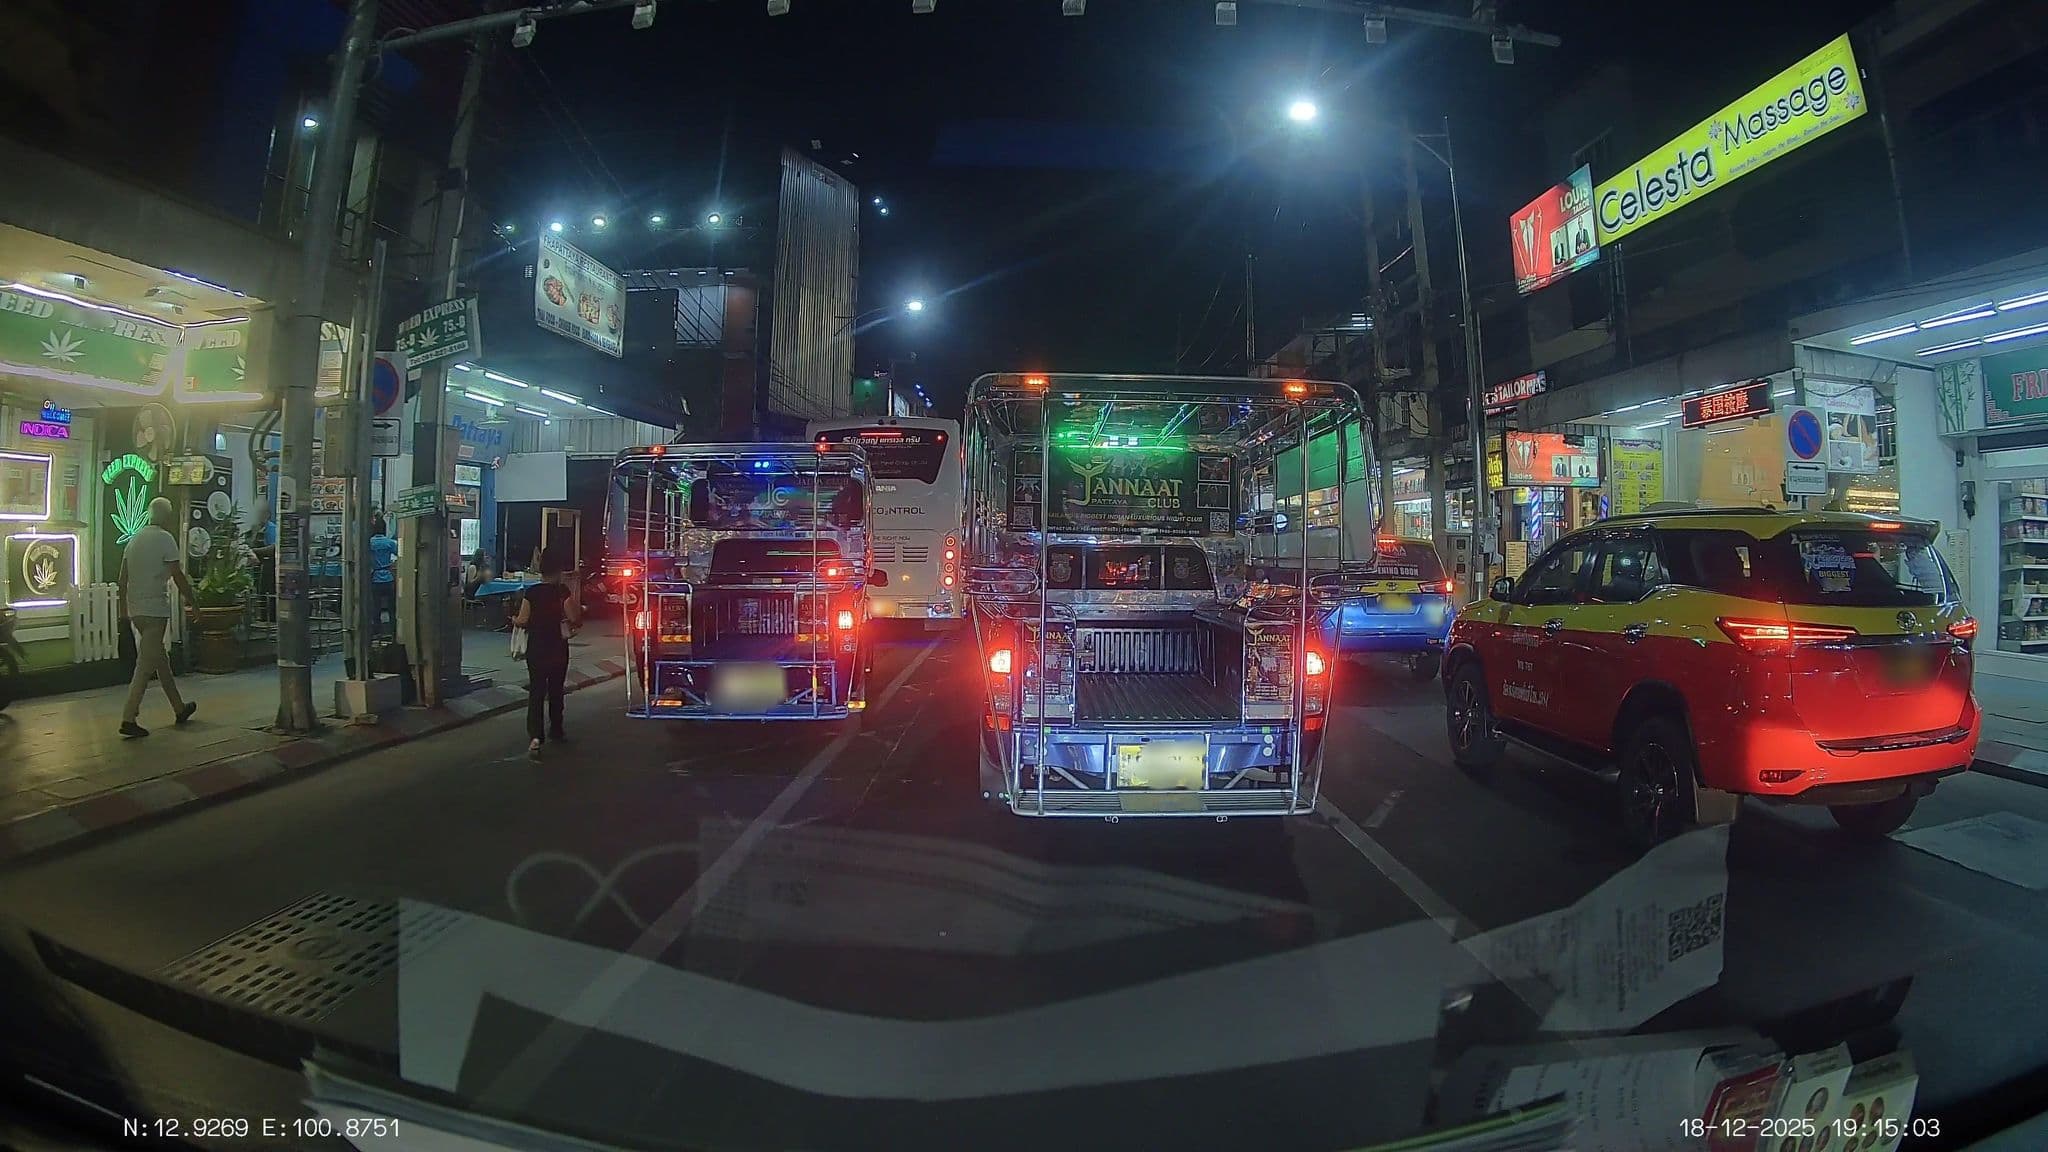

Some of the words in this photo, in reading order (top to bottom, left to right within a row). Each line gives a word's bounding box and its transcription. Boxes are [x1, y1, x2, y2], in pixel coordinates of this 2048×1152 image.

[1599, 145, 1714, 232] Celesta
[1722, 65, 1847, 155] Massage
[0, 292, 54, 319] EED
[423, 298, 465, 323] EXPRESS
[21, 422, 69, 438] INDICA
[1147, 497, 1181, 509] CLUB
